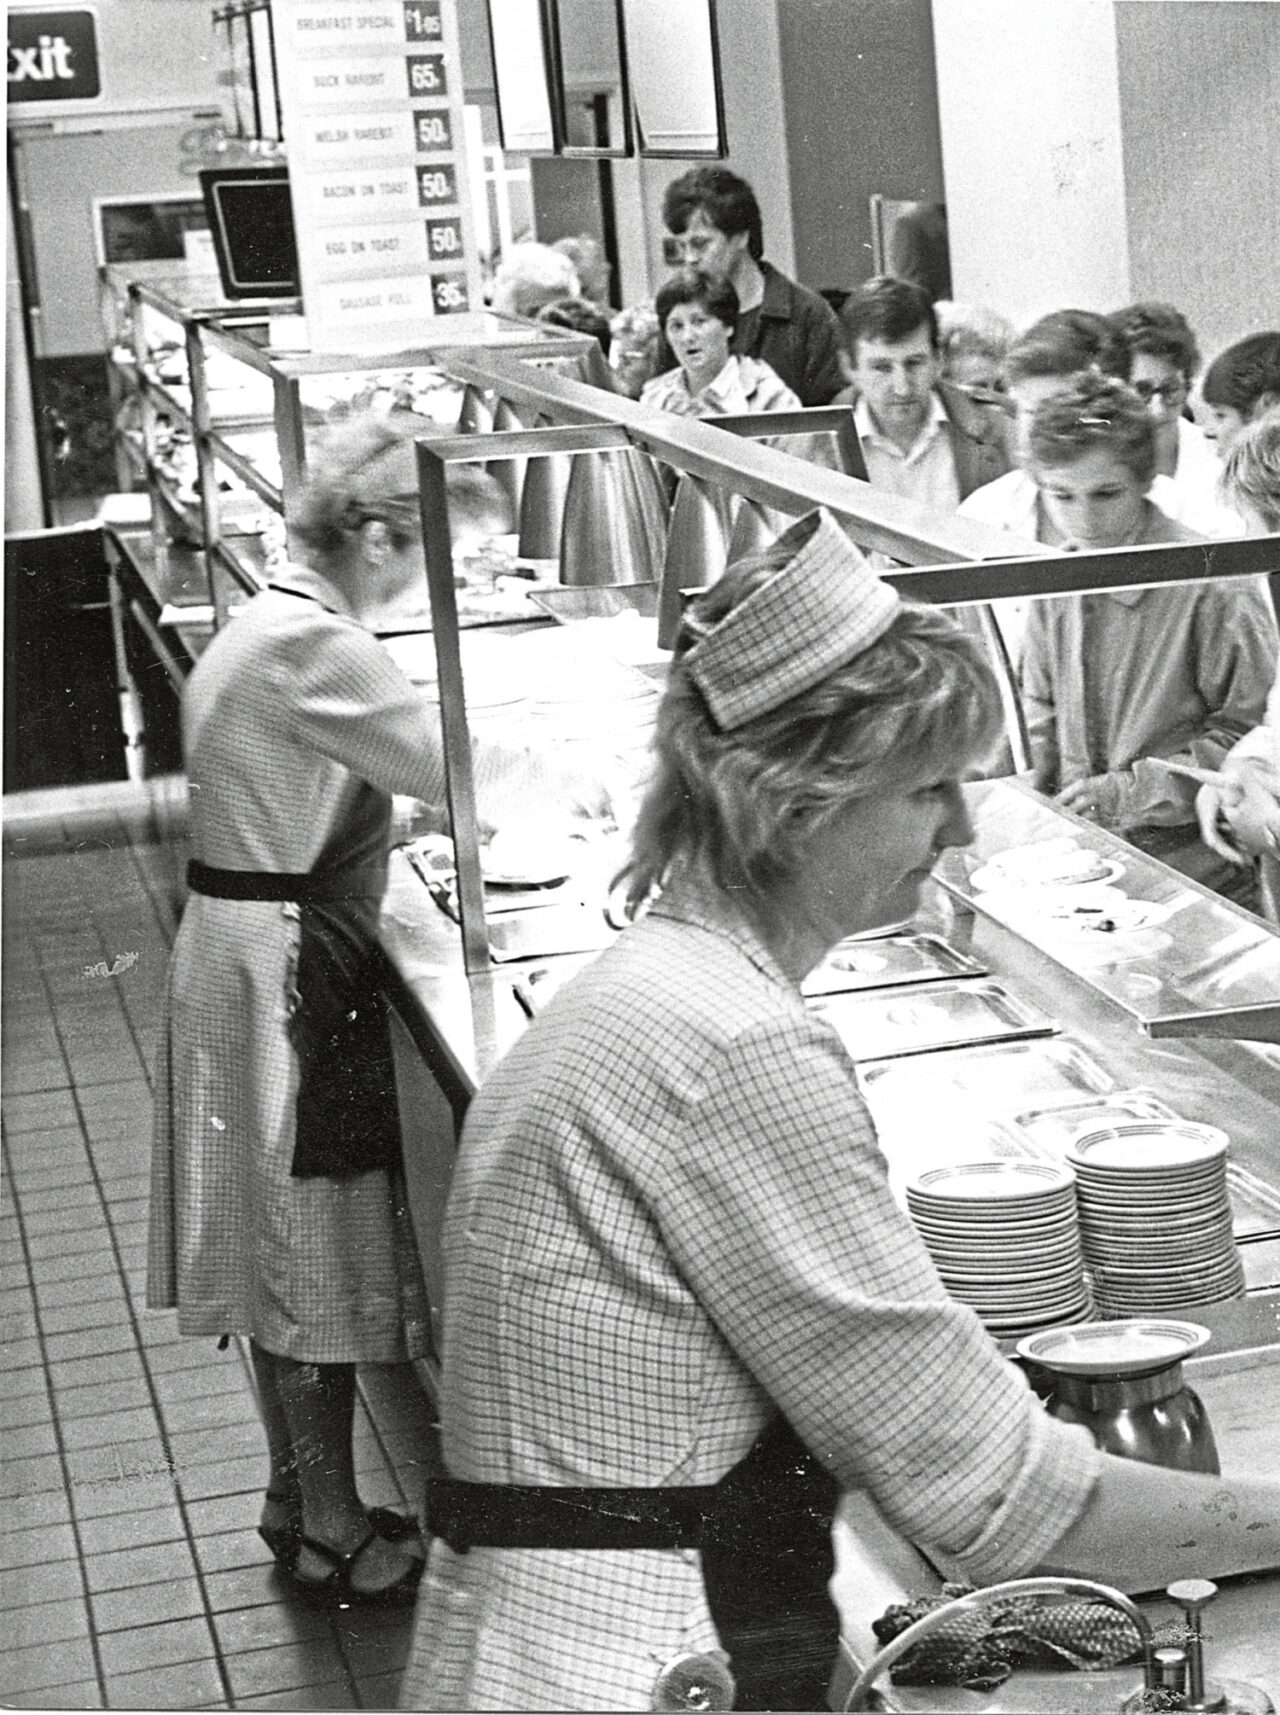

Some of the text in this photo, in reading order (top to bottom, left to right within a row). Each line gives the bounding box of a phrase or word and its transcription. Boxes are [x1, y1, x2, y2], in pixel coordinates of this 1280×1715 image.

[297, 16, 351, 30] BREAKFAST
[357, 15, 395, 29] SPECIAL
[8, 35, 75, 81] xit
[323, 185, 356, 198] BACON
[361, 185, 375, 197] ON
[379, 181, 408, 195] TOAST
[325, 241, 347, 255] EGG
[351, 241, 365, 254] ON
[371, 238, 399, 252] TOAST
